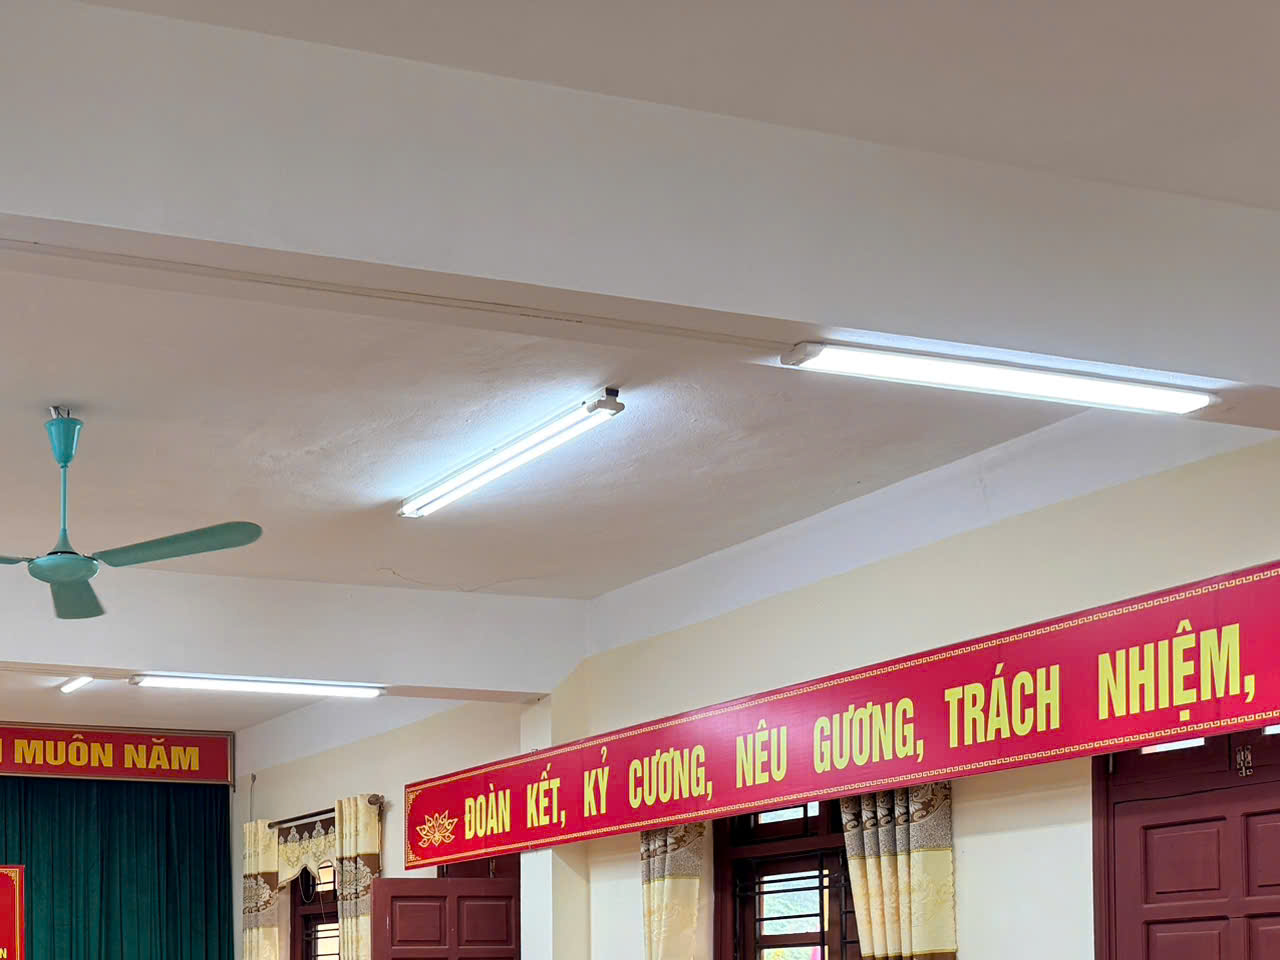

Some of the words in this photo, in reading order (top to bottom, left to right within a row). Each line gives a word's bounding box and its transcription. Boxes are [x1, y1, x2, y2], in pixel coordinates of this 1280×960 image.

[14, 733, 114, 768] MUÔN
[123, 738, 200, 771] NĂM
[464, 783, 511, 840] ĐOÀN
[526, 763, 566, 828] KẾT,
[583, 746, 610, 817] KỶ
[628, 744, 713, 809] CƯƠNG,
[735, 718, 787, 788] NÊU
[812, 697, 924, 774] GƯƠNG,
[944, 663, 1060, 748] TRÁCH
[1098, 618, 1255, 722] NHIỆM,
